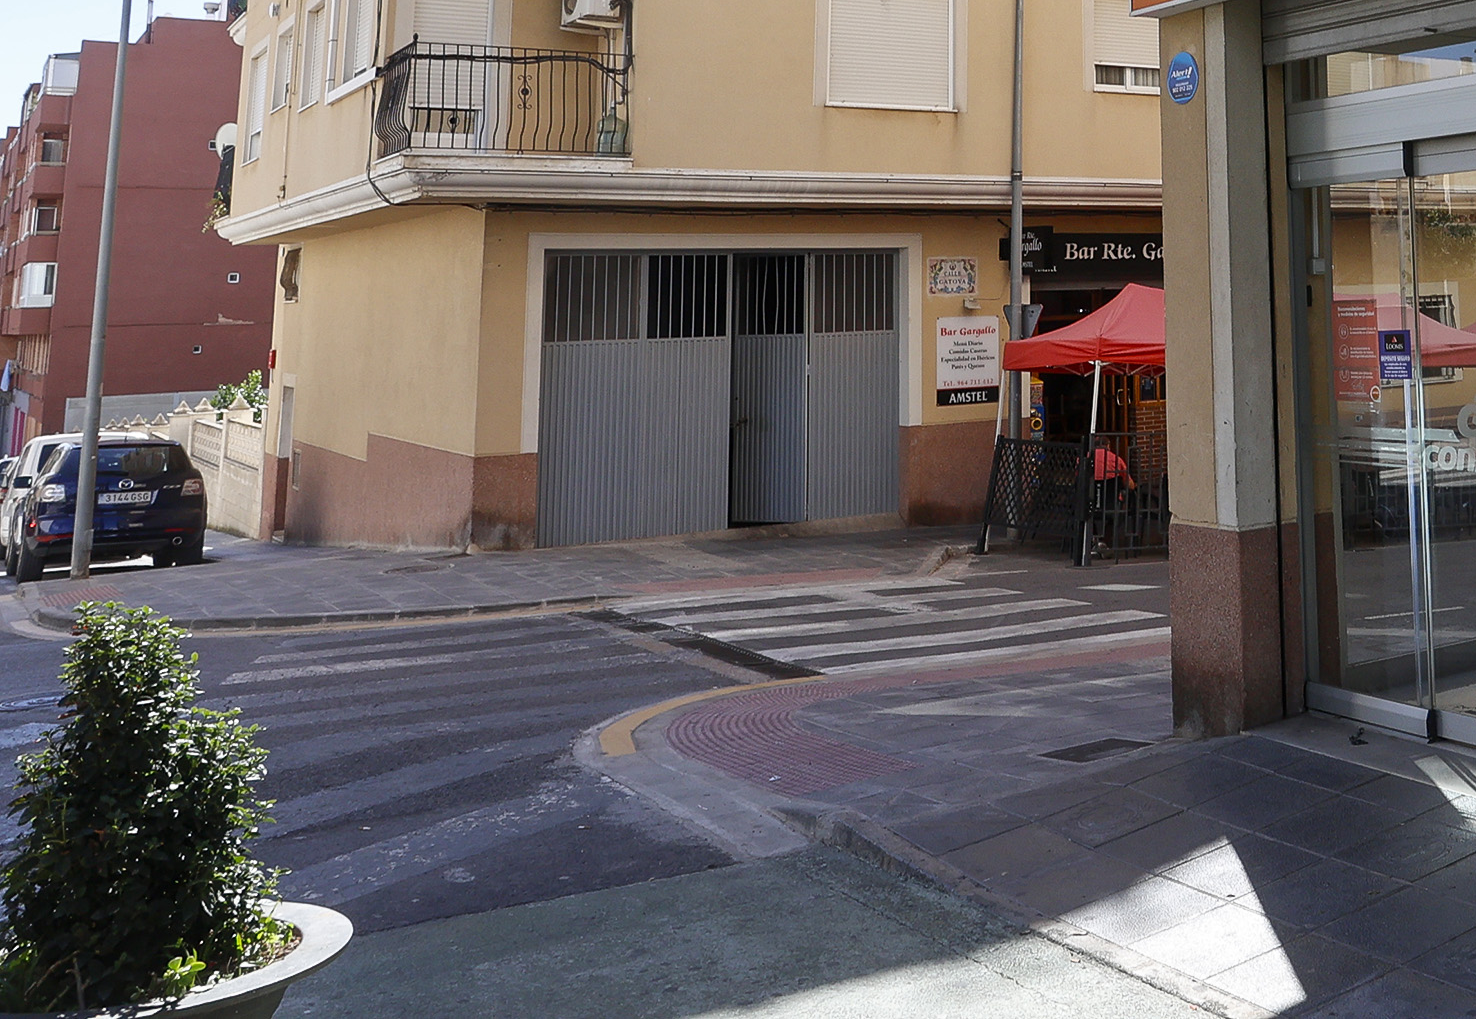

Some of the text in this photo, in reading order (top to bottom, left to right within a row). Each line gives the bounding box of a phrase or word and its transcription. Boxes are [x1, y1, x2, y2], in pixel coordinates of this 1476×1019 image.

[1064, 243, 1098, 260] Bar
[1102, 243, 1136, 260] Rte.
[940, 326, 996, 338] Bar Gargallo
[949, 392, 987, 403] AMSTEL
